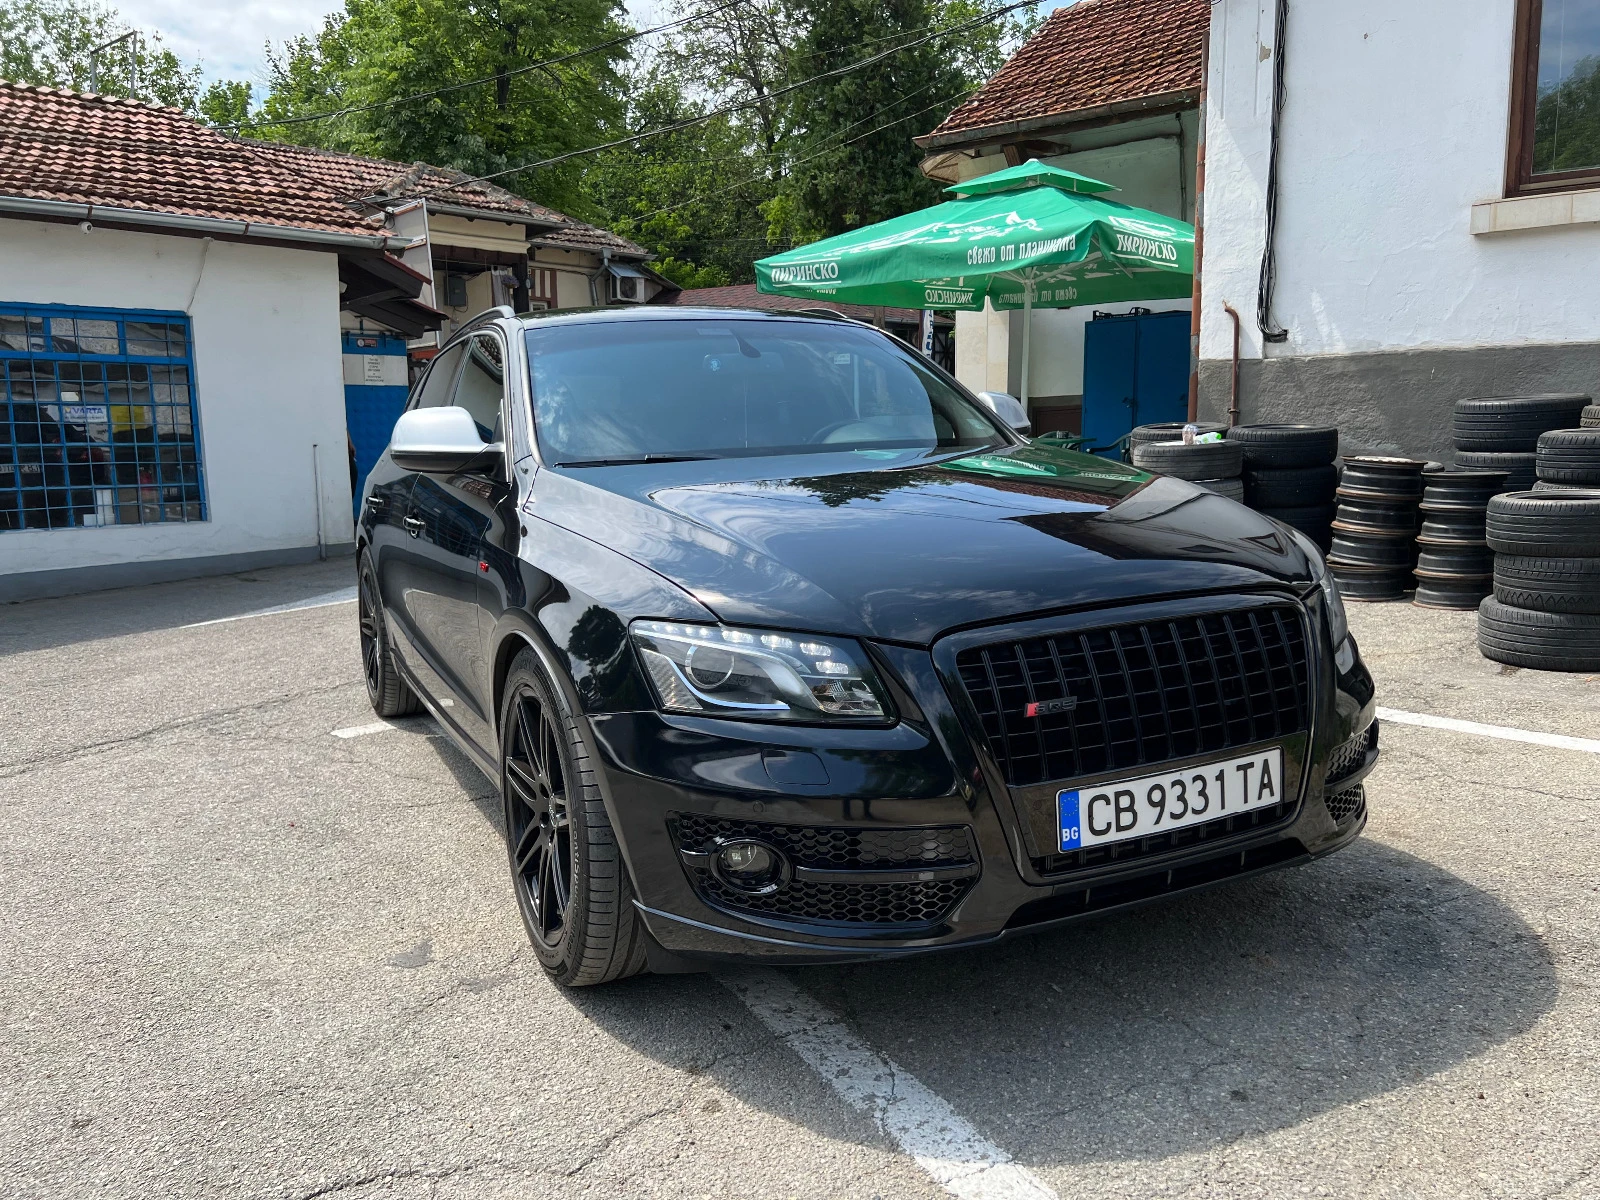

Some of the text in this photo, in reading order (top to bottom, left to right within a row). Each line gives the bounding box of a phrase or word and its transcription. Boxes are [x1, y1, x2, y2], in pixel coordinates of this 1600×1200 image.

[967, 245, 996, 265] свежо
[1116, 233, 1177, 261] ПИРИНСКО
[771, 262, 839, 283] ПИРИНСКО
[72, 407, 104, 415] VARTA
[1087, 758, 1275, 836] CB 9331 TA
[1062, 826, 1079, 842] BG
